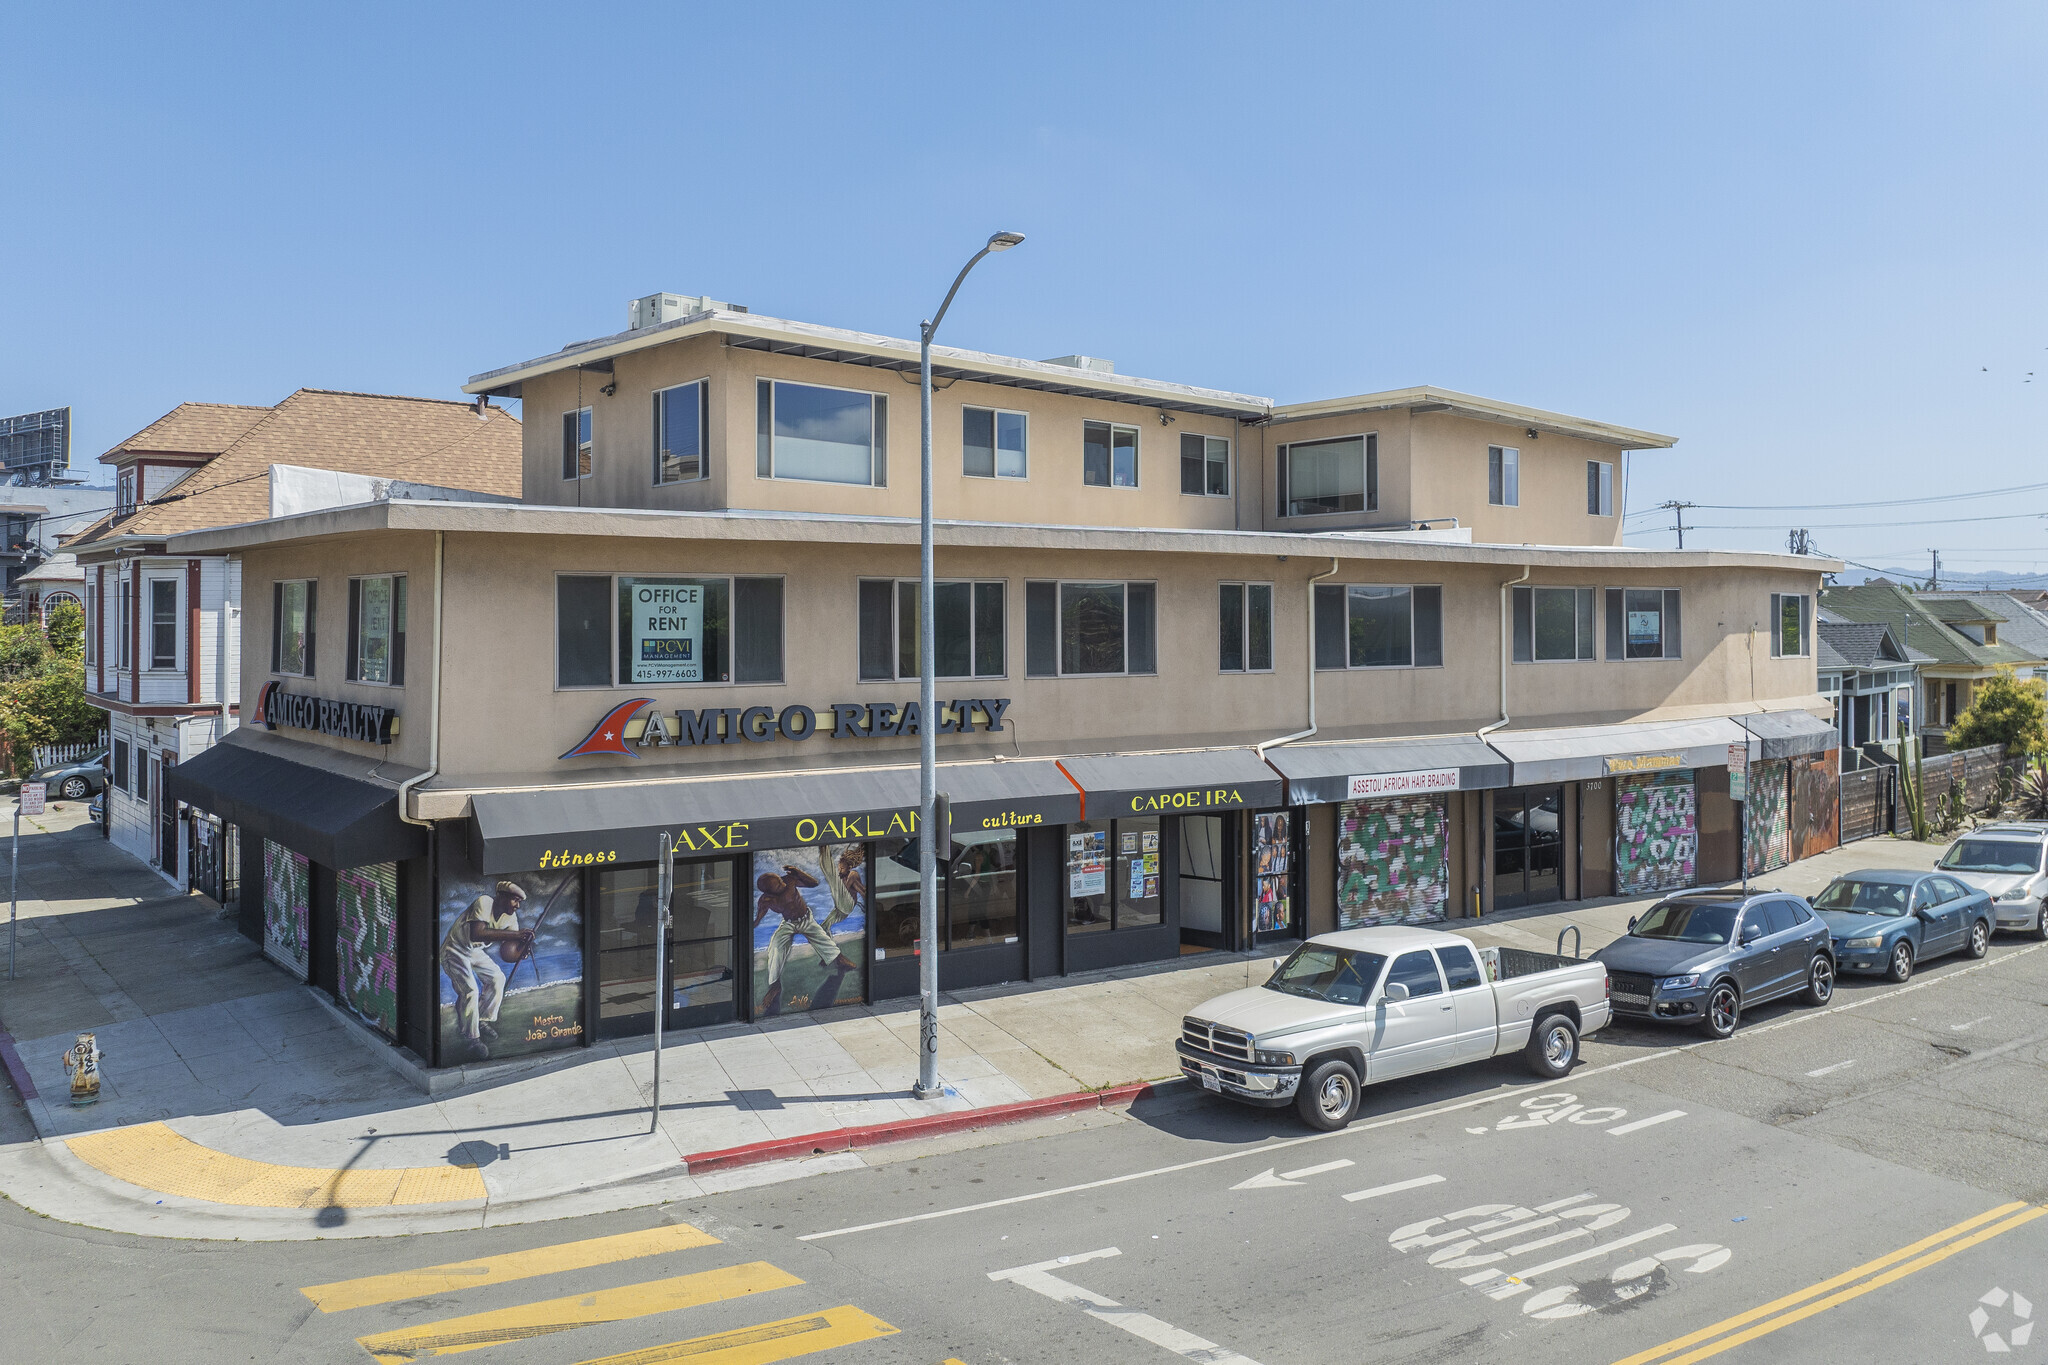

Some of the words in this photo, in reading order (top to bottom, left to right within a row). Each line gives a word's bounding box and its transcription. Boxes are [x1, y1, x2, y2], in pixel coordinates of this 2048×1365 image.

[638, 588, 698, 604] OFFICE
[658, 605, 678, 614] FOR
[648, 616, 688, 631] RENT
[656, 640, 690, 653] PCVI
[636, 669, 697, 679] 415-997-6603
[267, 691, 317, 731] AMIGO
[318, 699, 390, 745] REALTY
[639, 705, 817, 747] AMIGO
[829, 698, 1011, 739] REALTY
[1352, 778, 1382, 794] ASSETOU
[1383, 776, 1410, 791] AFRICAN
[1411, 774, 1426, 789] HAIR
[1427, 772, 1456, 788] BRAIDING
[1586, 781, 1602, 791] 3700
[1131, 789, 1243, 812] CAPOEIRA
[795, 810, 952, 843] OAKLAN
[982, 811, 1043, 829] cultura
[539, 849, 617, 869] fitness
[533, 1014, 564, 1026] Mestre
[525, 1029, 547, 1042] João
[550, 1021, 583, 1038] Grande
[1387, 1193, 1733, 1320] STOP
